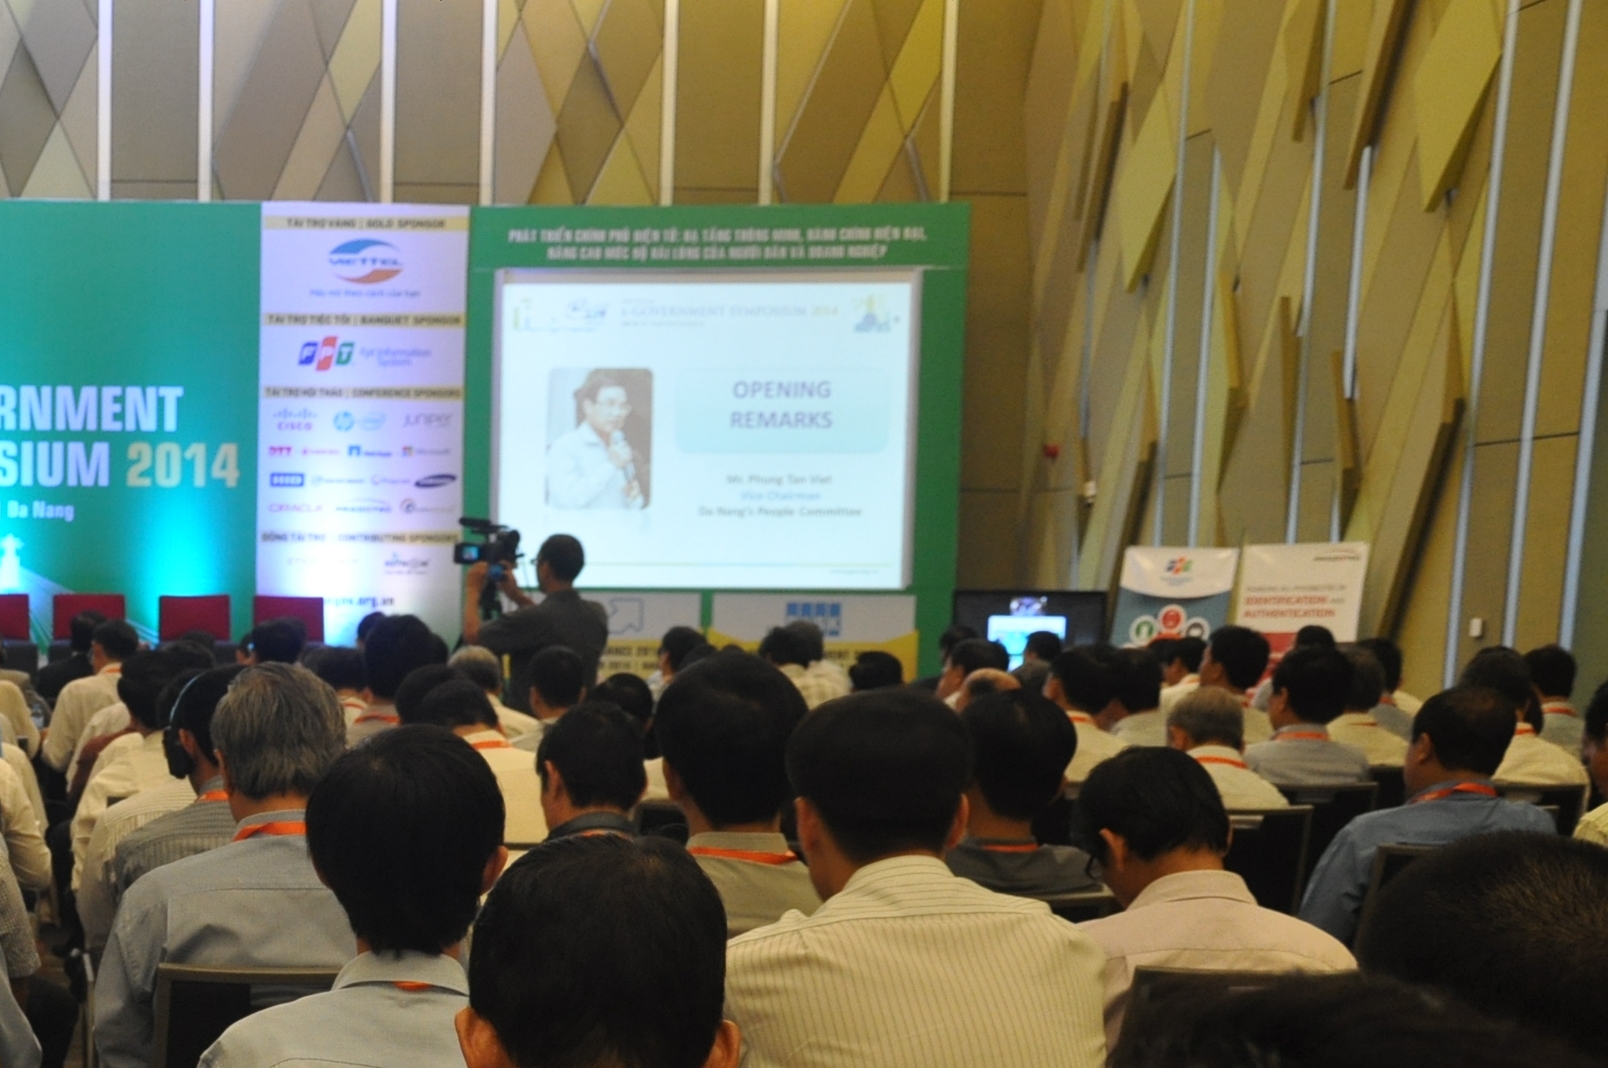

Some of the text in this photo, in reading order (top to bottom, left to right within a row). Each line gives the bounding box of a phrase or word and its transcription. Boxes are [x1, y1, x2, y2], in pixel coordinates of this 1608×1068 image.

[732, 381, 832, 400] OPENING
[730, 411, 833, 430] REMARKS
[126, 442, 240, 488] 2014
[7, 500, 28, 519] Da
[32, 500, 74, 522] Nang
